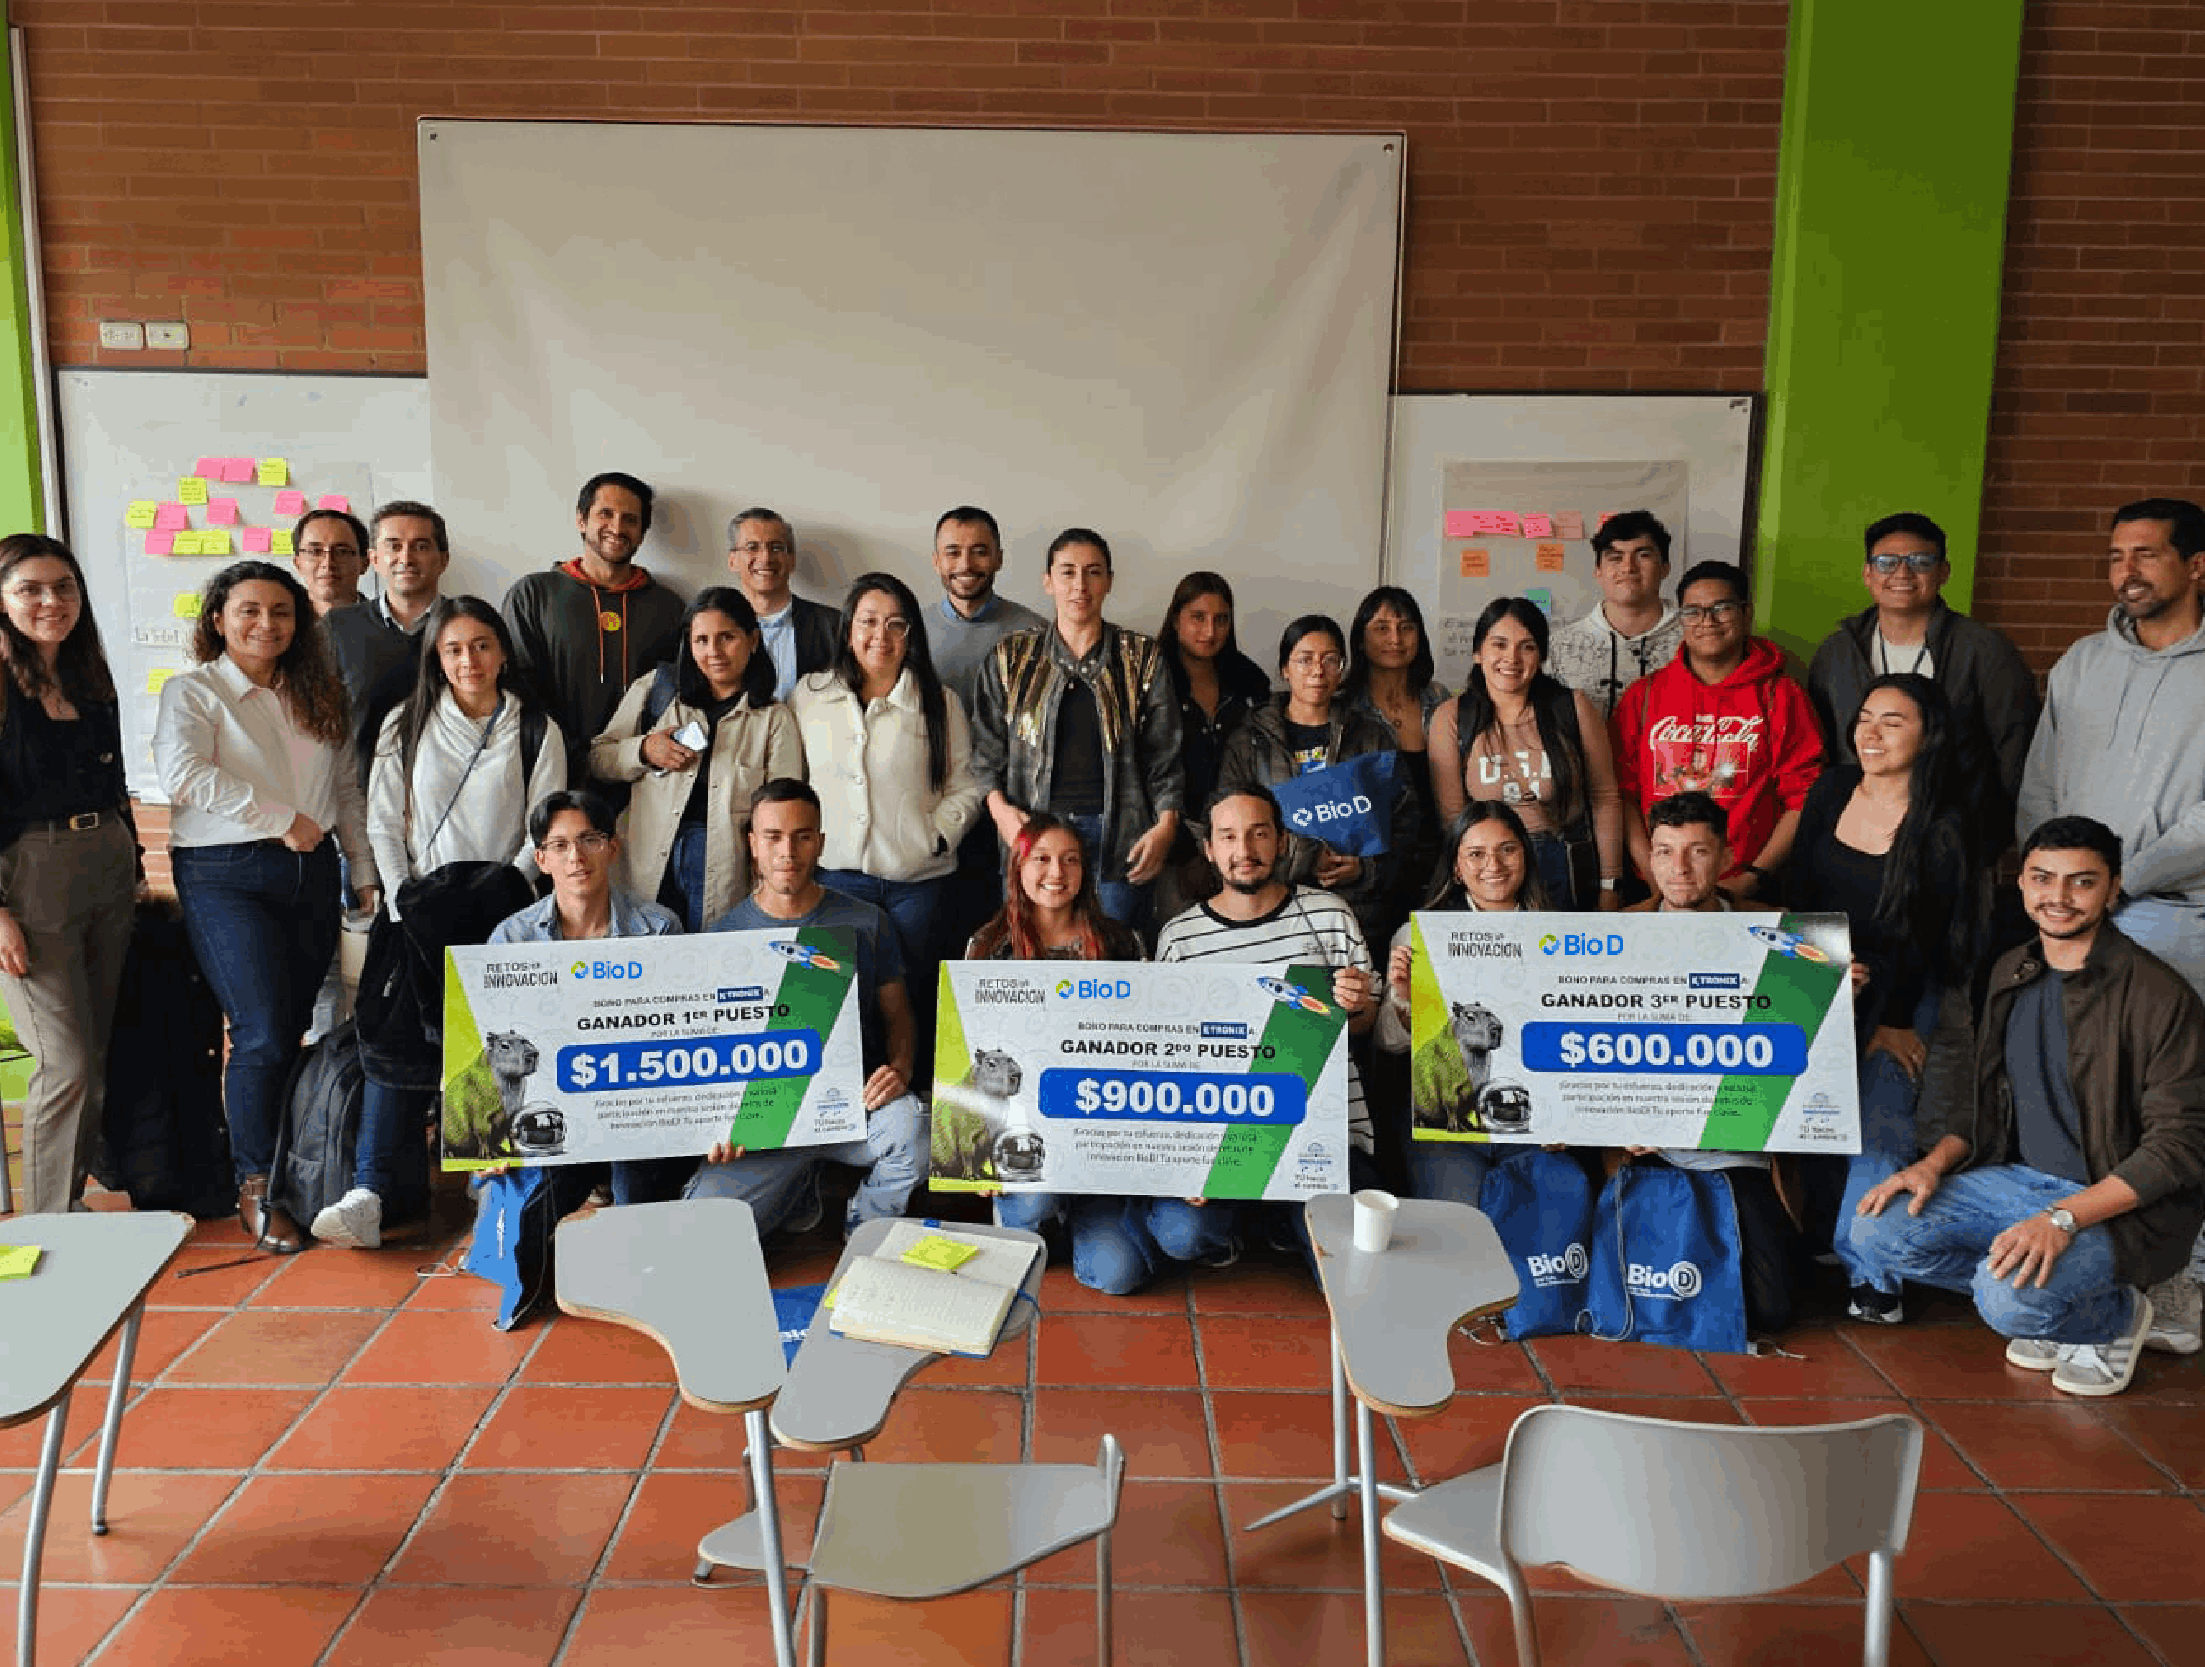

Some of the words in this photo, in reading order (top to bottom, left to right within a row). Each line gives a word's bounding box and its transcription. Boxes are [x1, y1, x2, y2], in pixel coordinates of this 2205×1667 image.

[577, 1010, 676, 1031] GANADOR
[713, 1002, 791, 1023] PUESTO
[1540, 993, 1644, 1009] GANADOR
[1685, 993, 1772, 1010] PUESTO
[570, 1039, 808, 1089] $1.500.000
[1060, 1040, 1159, 1056] GANADOR
[1196, 1044, 1276, 1060] PUESTO
[1558, 1031, 1774, 1068] $600.000
[1074, 1077, 1274, 1118] $900.000
